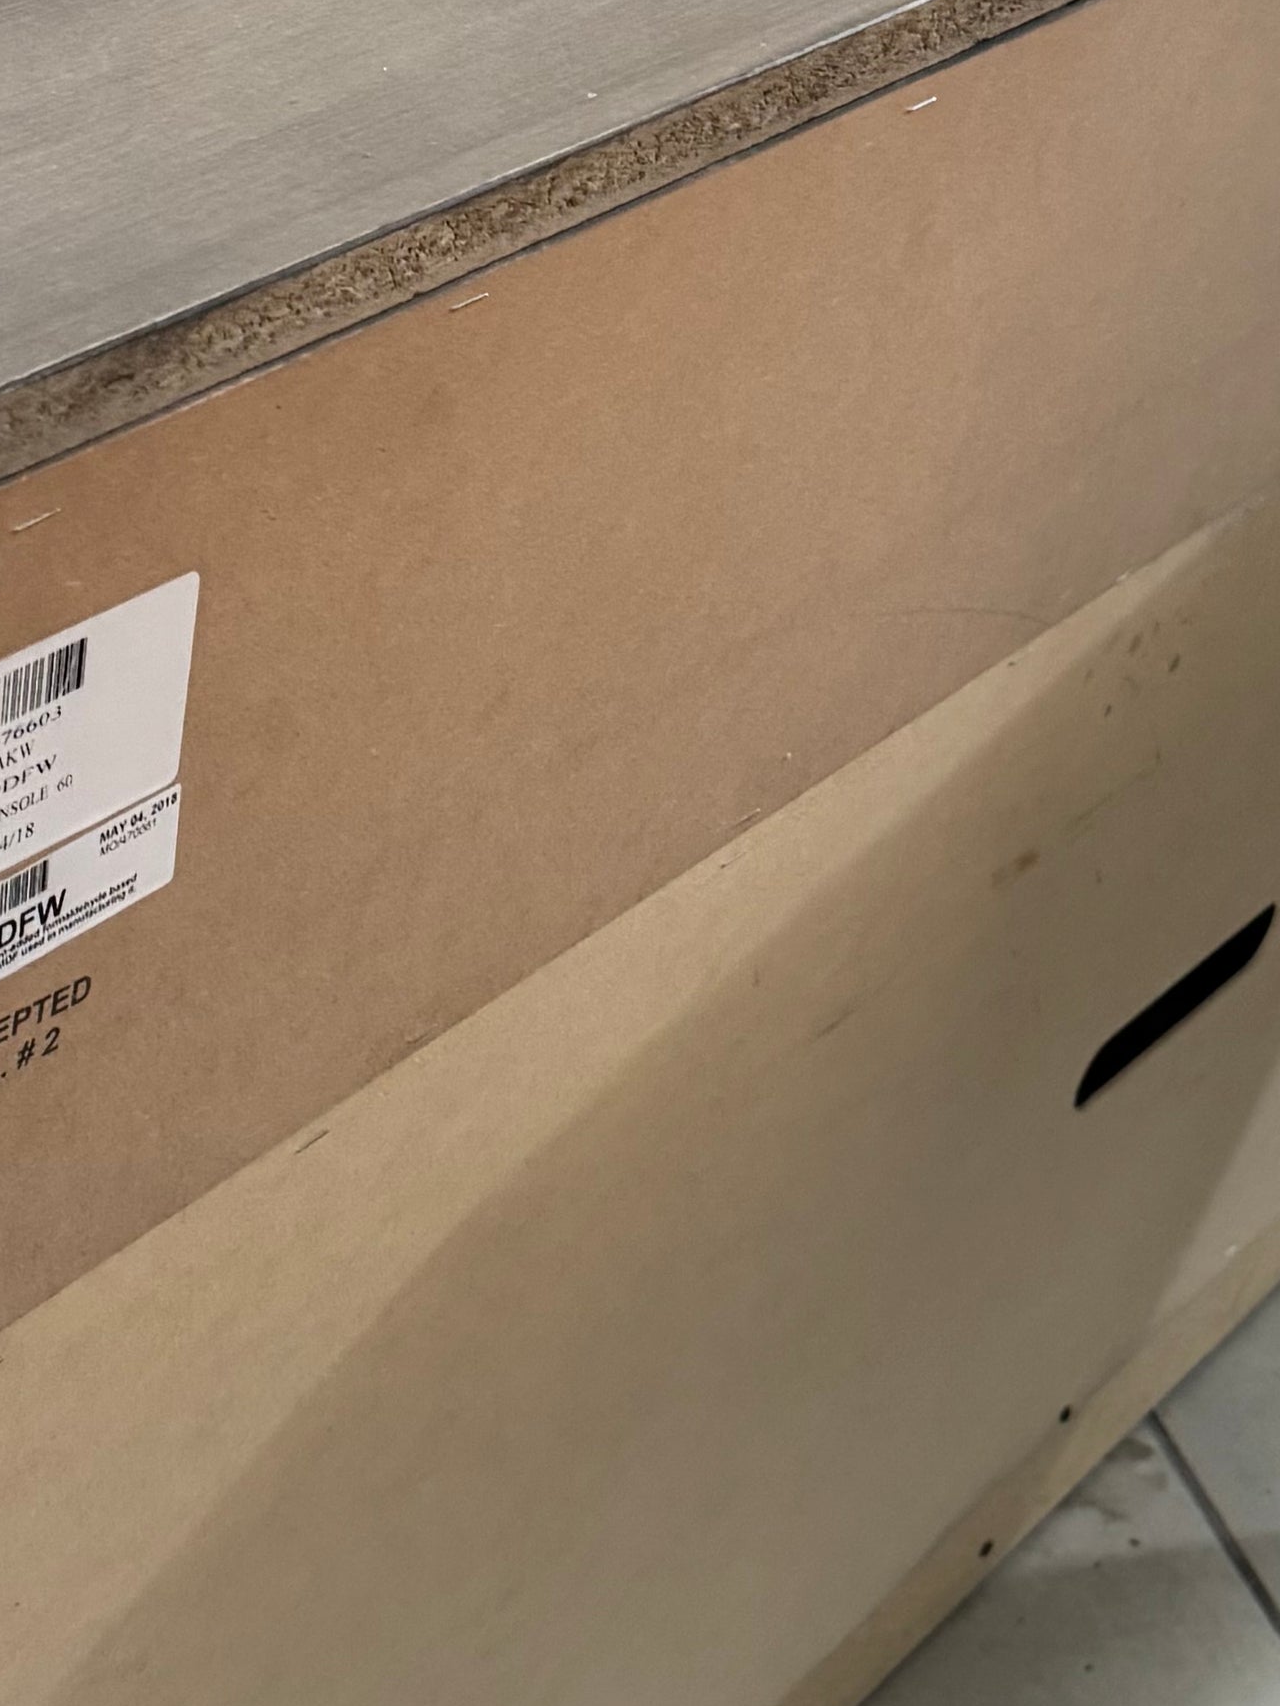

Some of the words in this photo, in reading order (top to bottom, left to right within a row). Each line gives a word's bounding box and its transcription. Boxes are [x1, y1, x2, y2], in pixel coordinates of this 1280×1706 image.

[57, 772, 73, 792] 60
[99, 819, 126, 843] MAY
[152, 791, 177, 815] 2018
[109, 872, 137, 896] based
[21, 935, 44, 956] used
[58, 889, 125, 937] manufacturing
